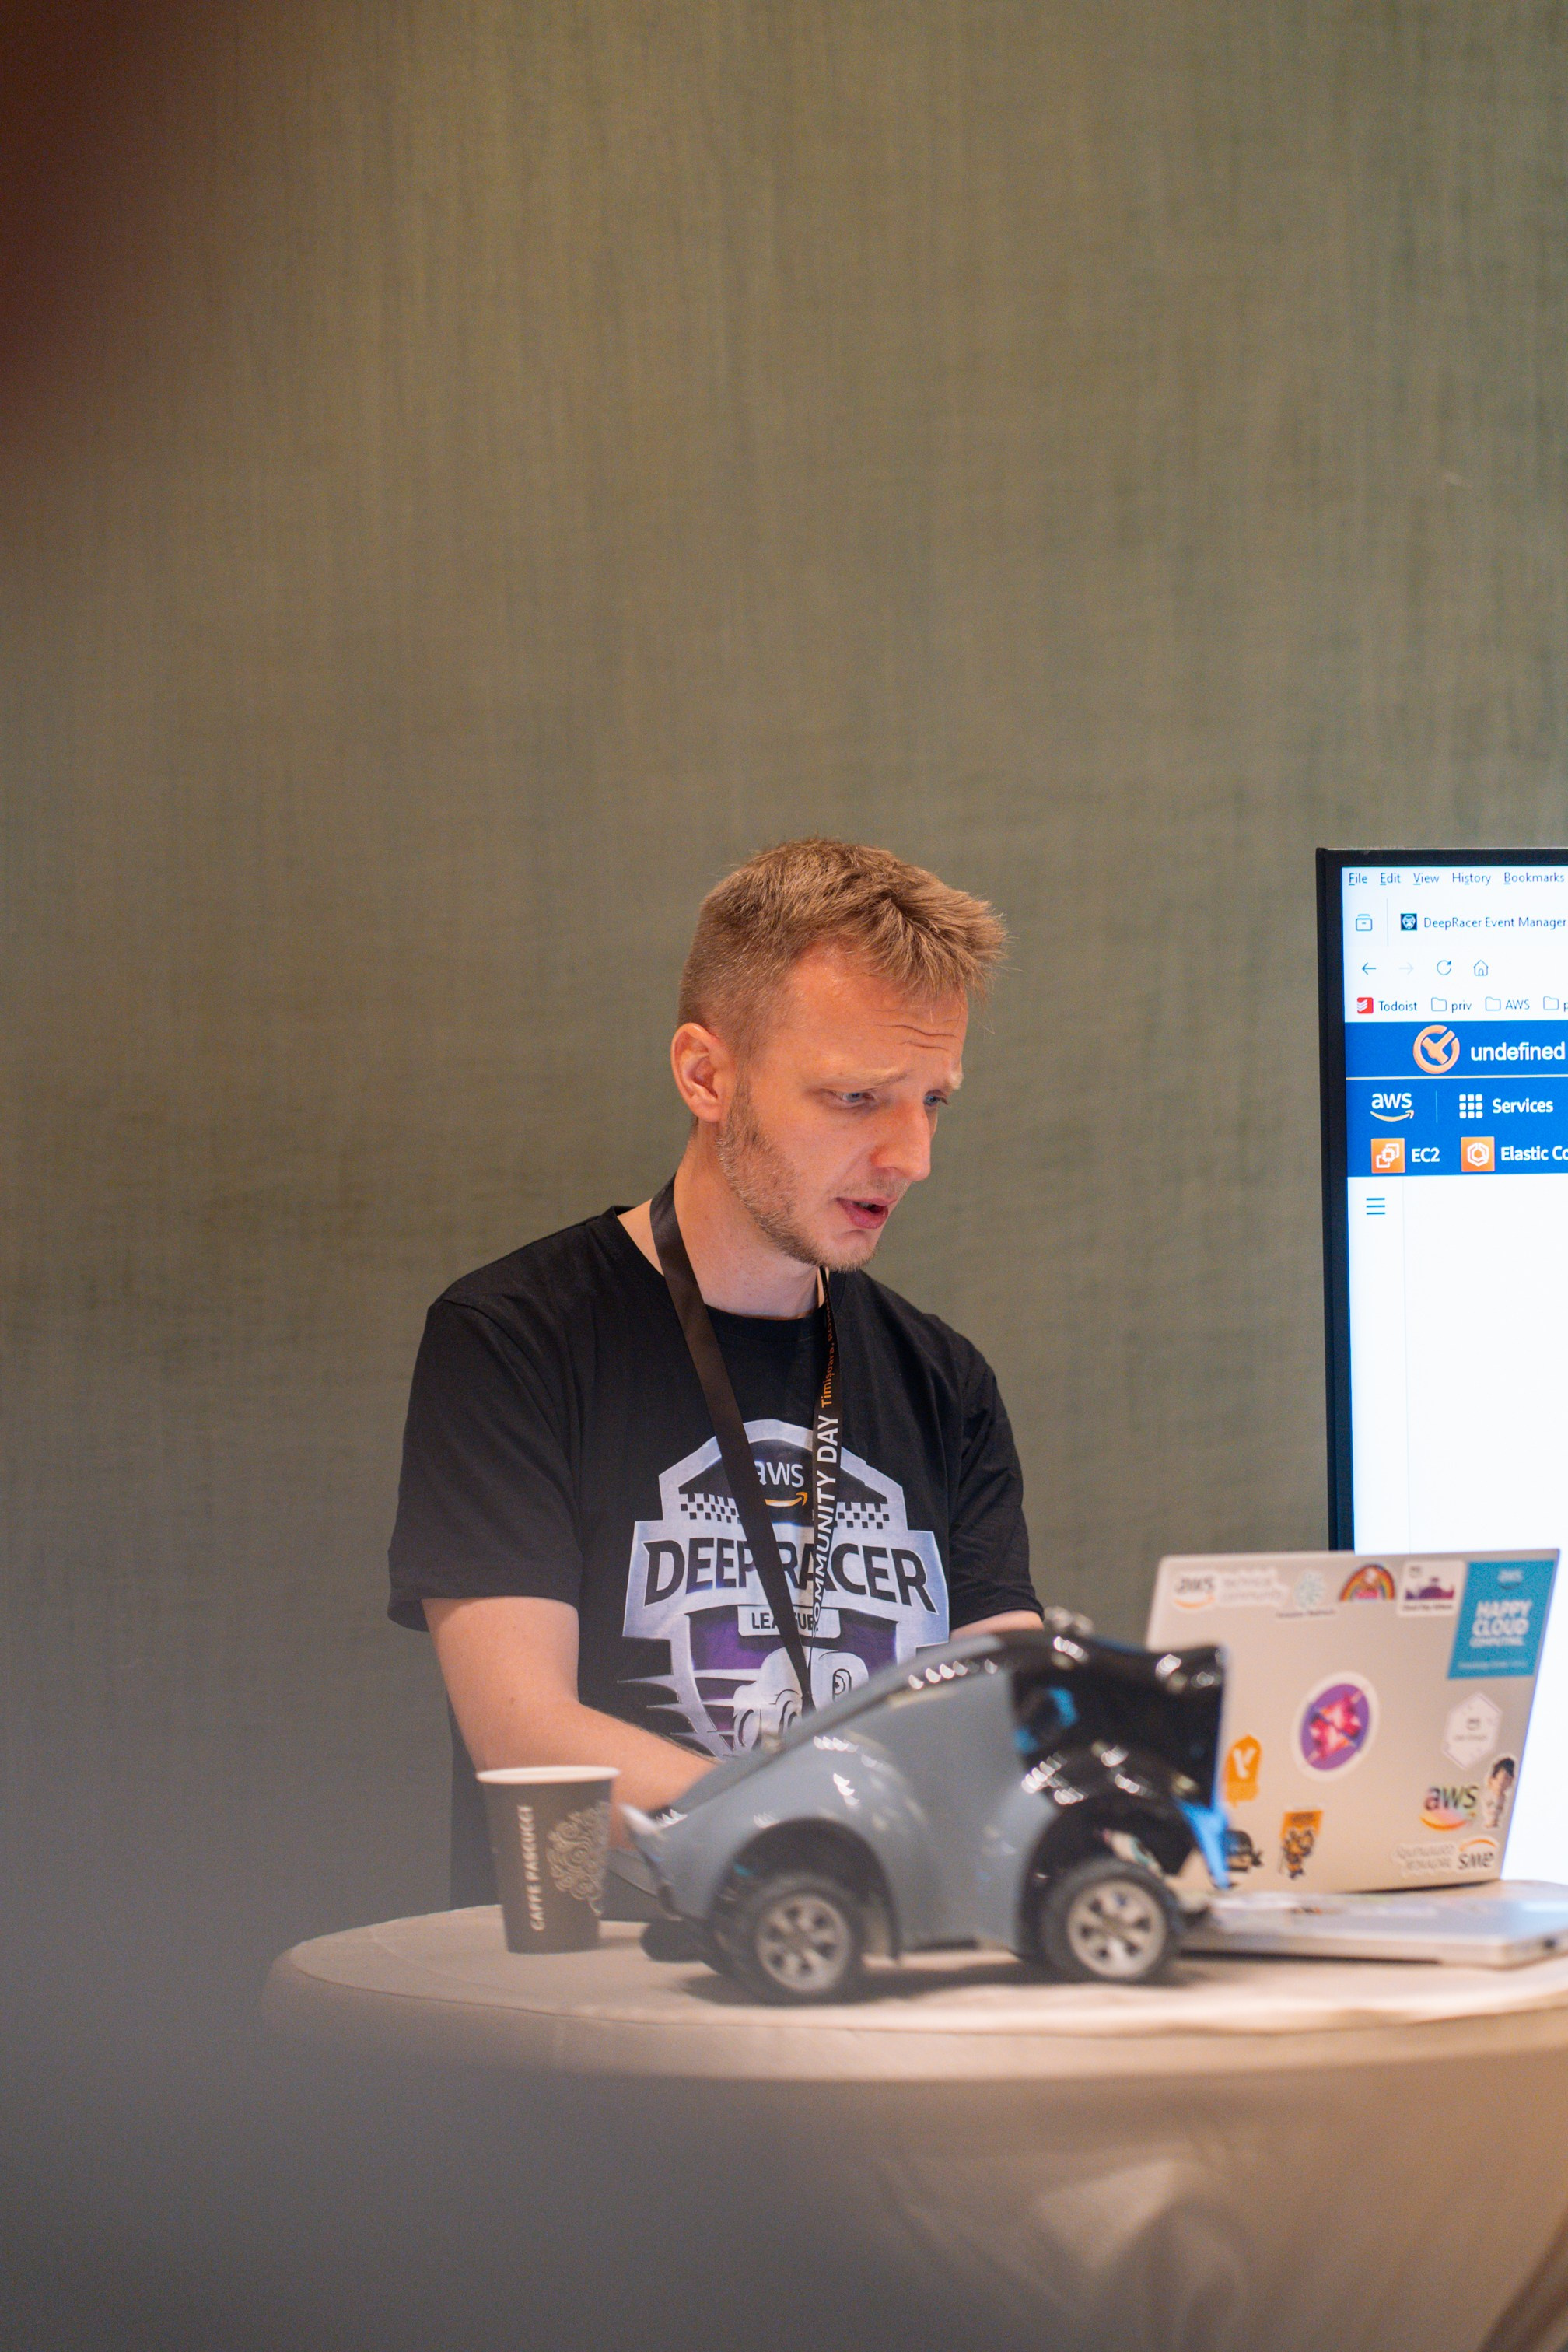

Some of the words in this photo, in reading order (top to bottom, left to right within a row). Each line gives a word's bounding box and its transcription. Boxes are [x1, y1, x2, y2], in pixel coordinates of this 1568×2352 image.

[1349, 873, 1368, 886] File
[1380, 872, 1401, 886] Edit
[1413, 872, 1440, 885] View
[1452, 872, 1491, 885] History
[1503, 871, 1565, 884] Bookmarks
[1423, 917, 1482, 933] DeepRacer
[1486, 916, 1515, 928] Event
[1518, 916, 1566, 931] Manager
[1379, 1000, 1418, 1012] Todoist
[1451, 1000, 1472, 1014] priv
[1505, 999, 1530, 1010] AWS
[1471, 1041, 1566, 1061] undefined
[1371, 1093, 1412, 1109] aws
[1492, 1097, 1554, 1114] Services
[1411, 1147, 1440, 1163] EC2
[1500, 1146, 1549, 1162] Elastic
[817, 1415, 839, 1465] DAY
[1475, 1600, 1532, 1619] HAPPY
[751, 1612, 819, 1632] LEUE
[1472, 1618, 1529, 1636] CLOUD
[1424, 1786, 1479, 1811] aws
